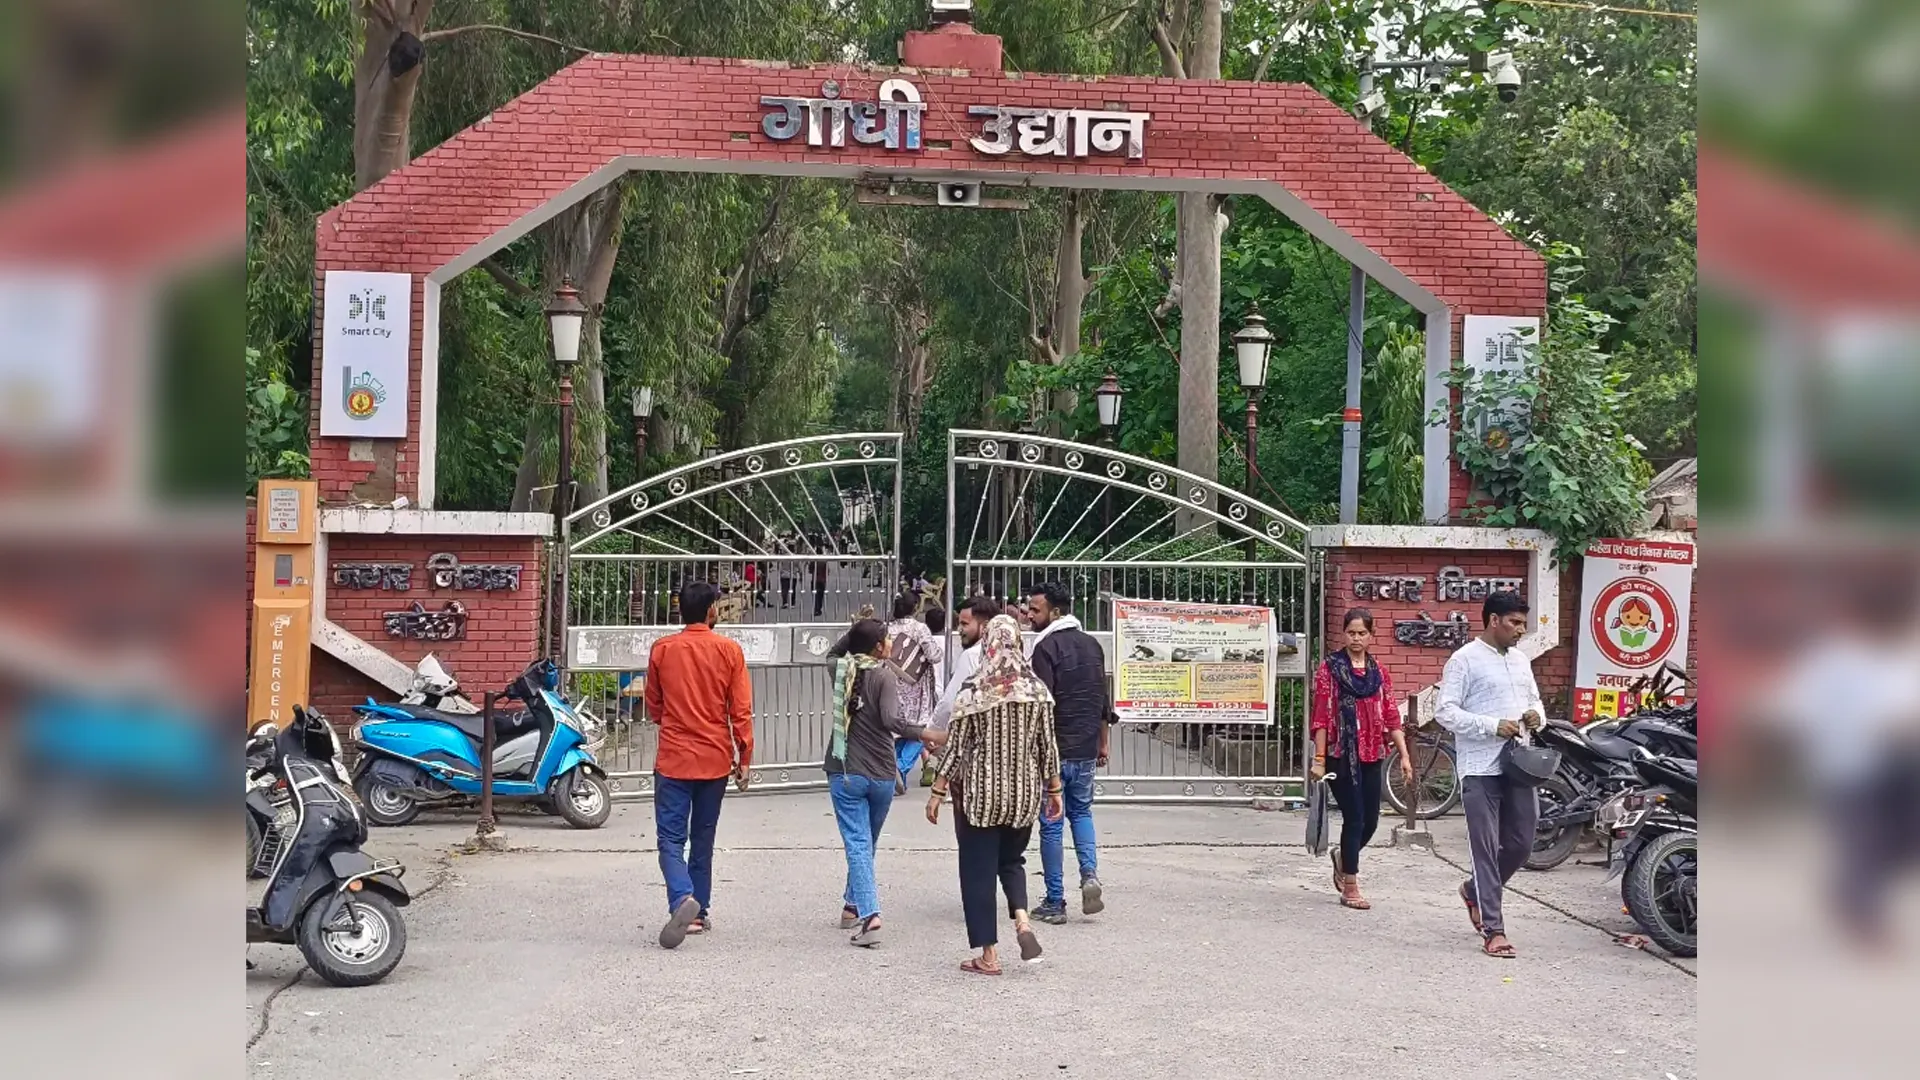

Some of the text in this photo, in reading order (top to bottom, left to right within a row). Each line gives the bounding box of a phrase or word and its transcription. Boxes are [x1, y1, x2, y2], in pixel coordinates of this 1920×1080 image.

[760, 79, 1150, 159] गांधी उद्यान
[341, 327, 392, 338] Smart City
[1596, 673, 1632, 687] जनपद
